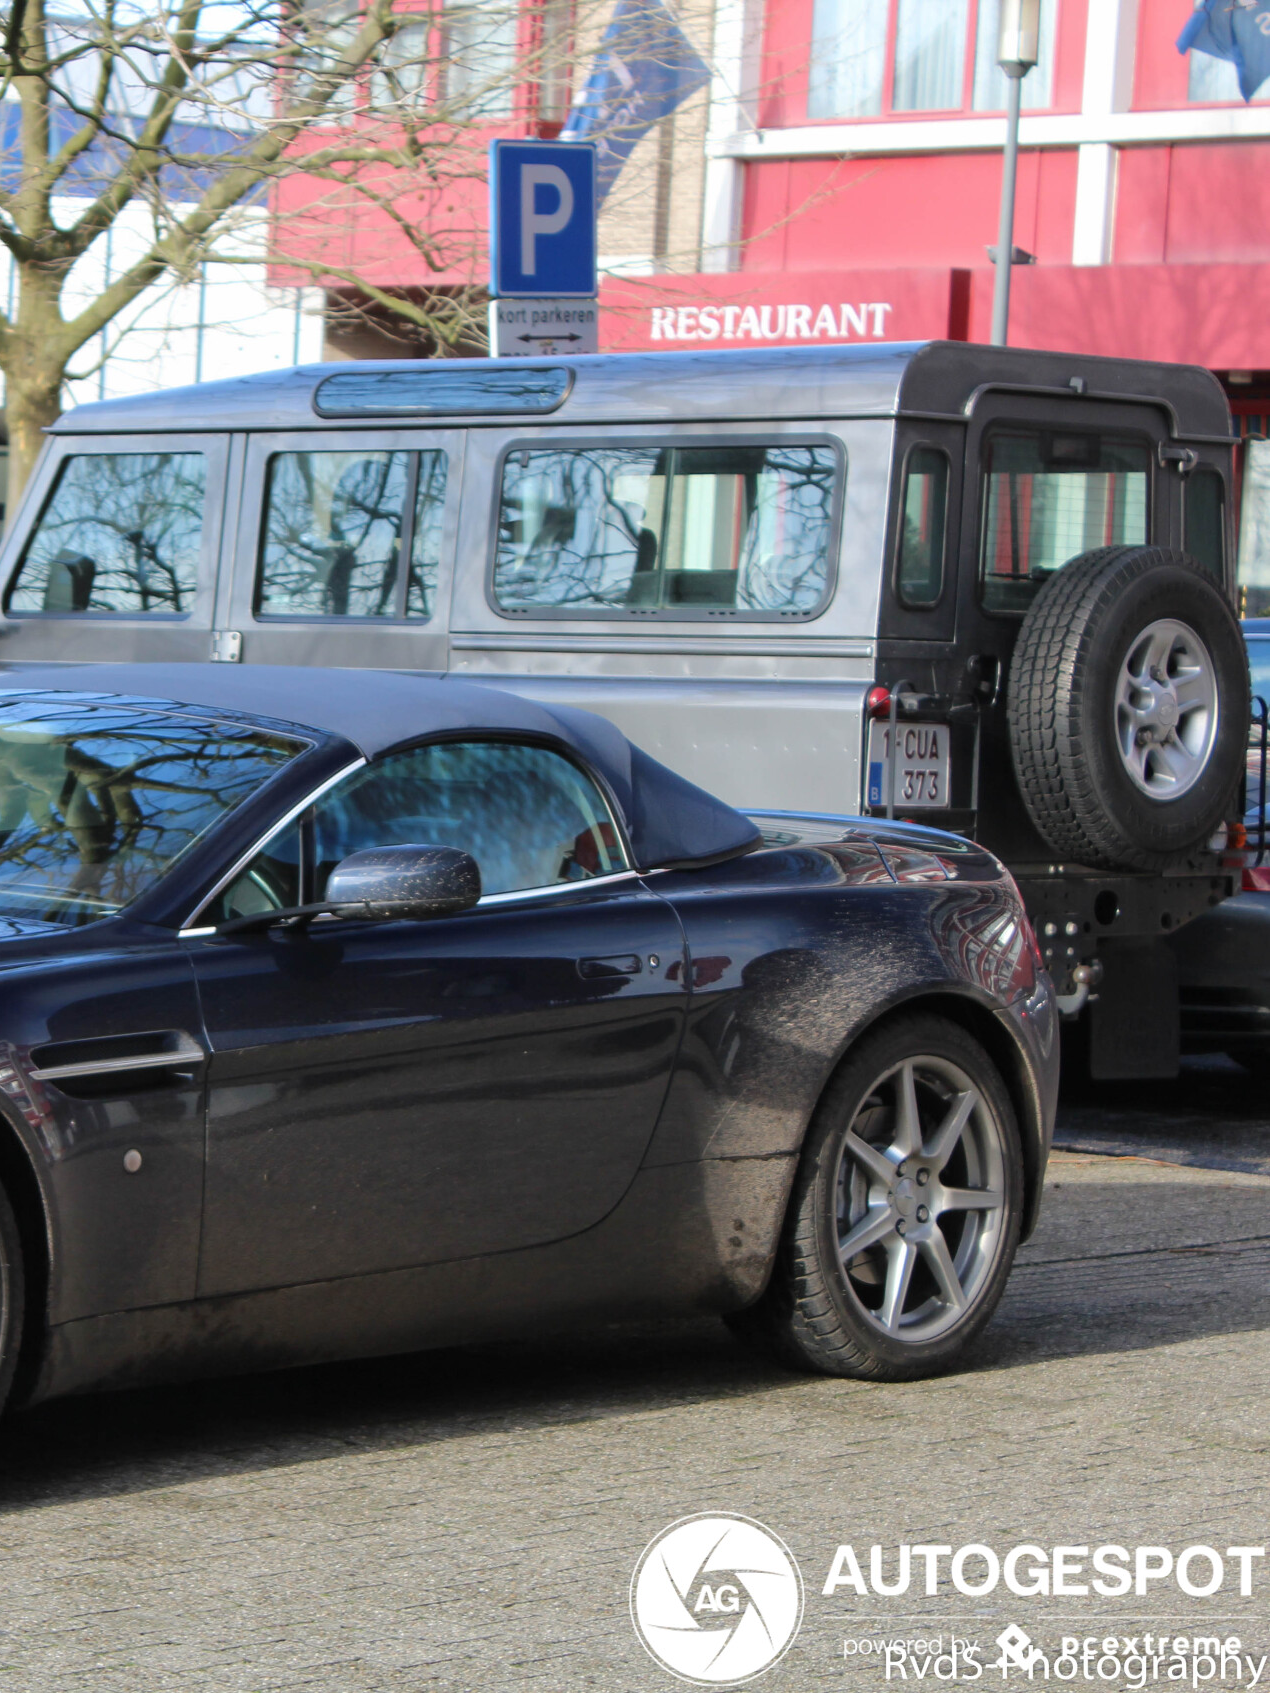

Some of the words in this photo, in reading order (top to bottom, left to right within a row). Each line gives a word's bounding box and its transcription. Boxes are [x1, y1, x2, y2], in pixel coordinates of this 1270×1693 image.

[521, 163, 574, 276] P
[499, 307, 527, 323] kort
[532, 307, 594, 328] parkeren
[650, 303, 892, 340] RESTAURANT
[871, 787, 878, 800] B
[902, 769, 939, 800] 373
